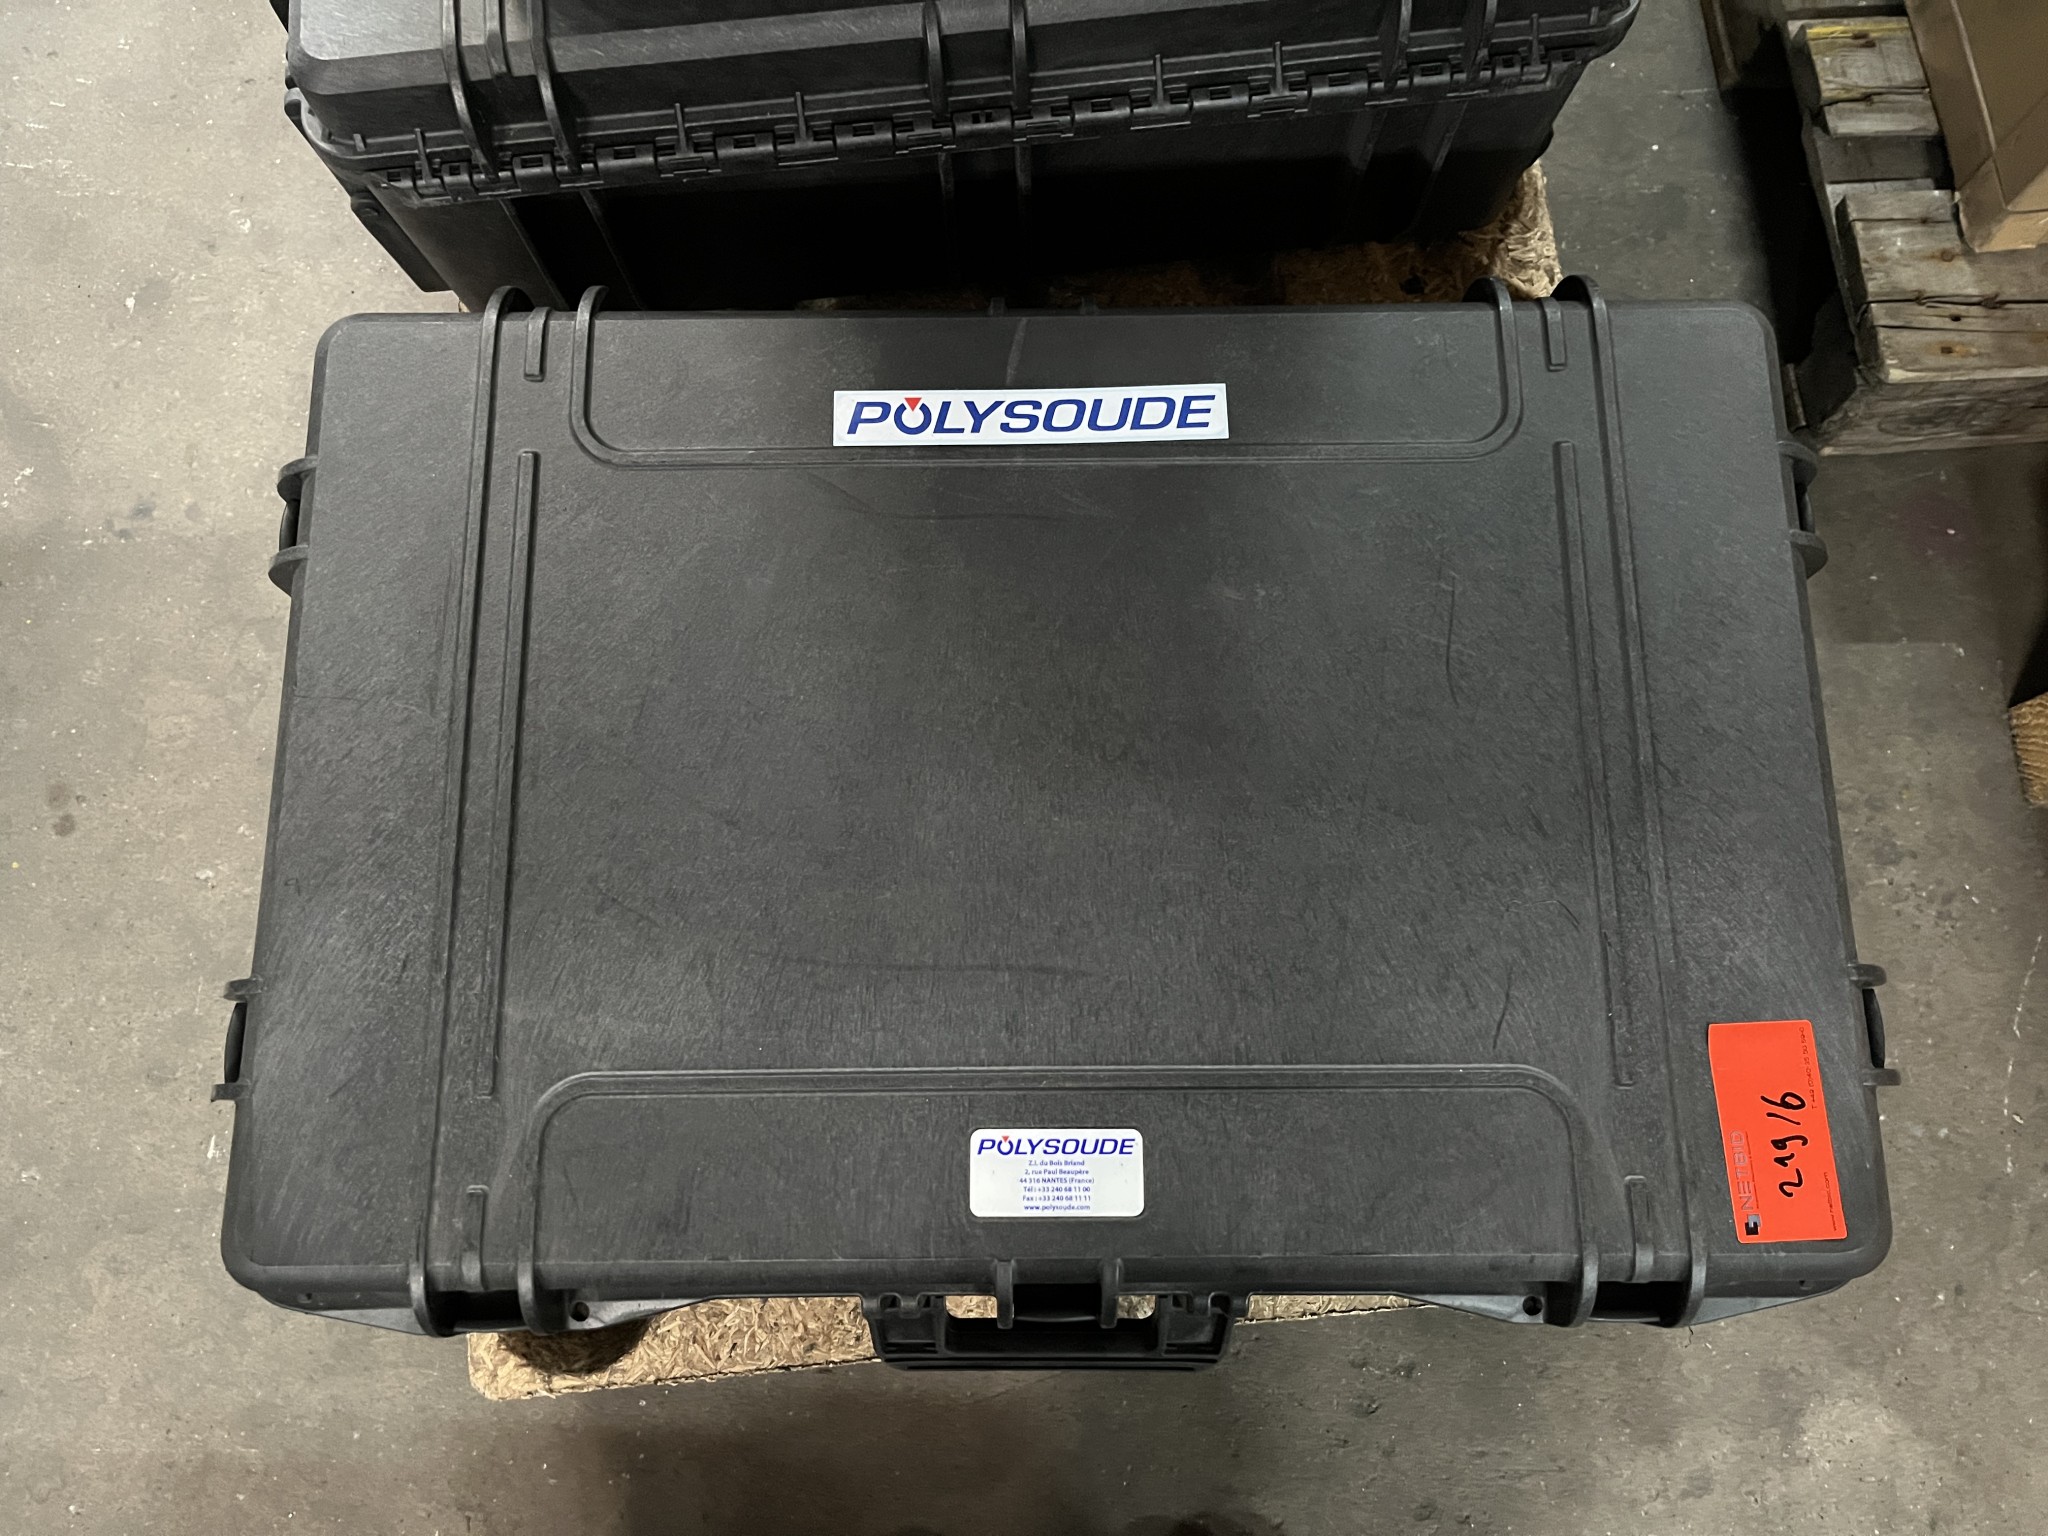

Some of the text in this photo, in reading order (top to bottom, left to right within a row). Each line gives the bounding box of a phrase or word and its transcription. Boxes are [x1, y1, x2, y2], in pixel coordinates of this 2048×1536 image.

[847, 395, 1216, 435] POLYSOUDE
[977, 1137, 1136, 1156] POLYSOUDE
[1058, 1168, 1089, 1177] Beaupère
[1730, 1130, 1754, 1211] NETBID
[1069, 1177, 1095, 1185] (France)
